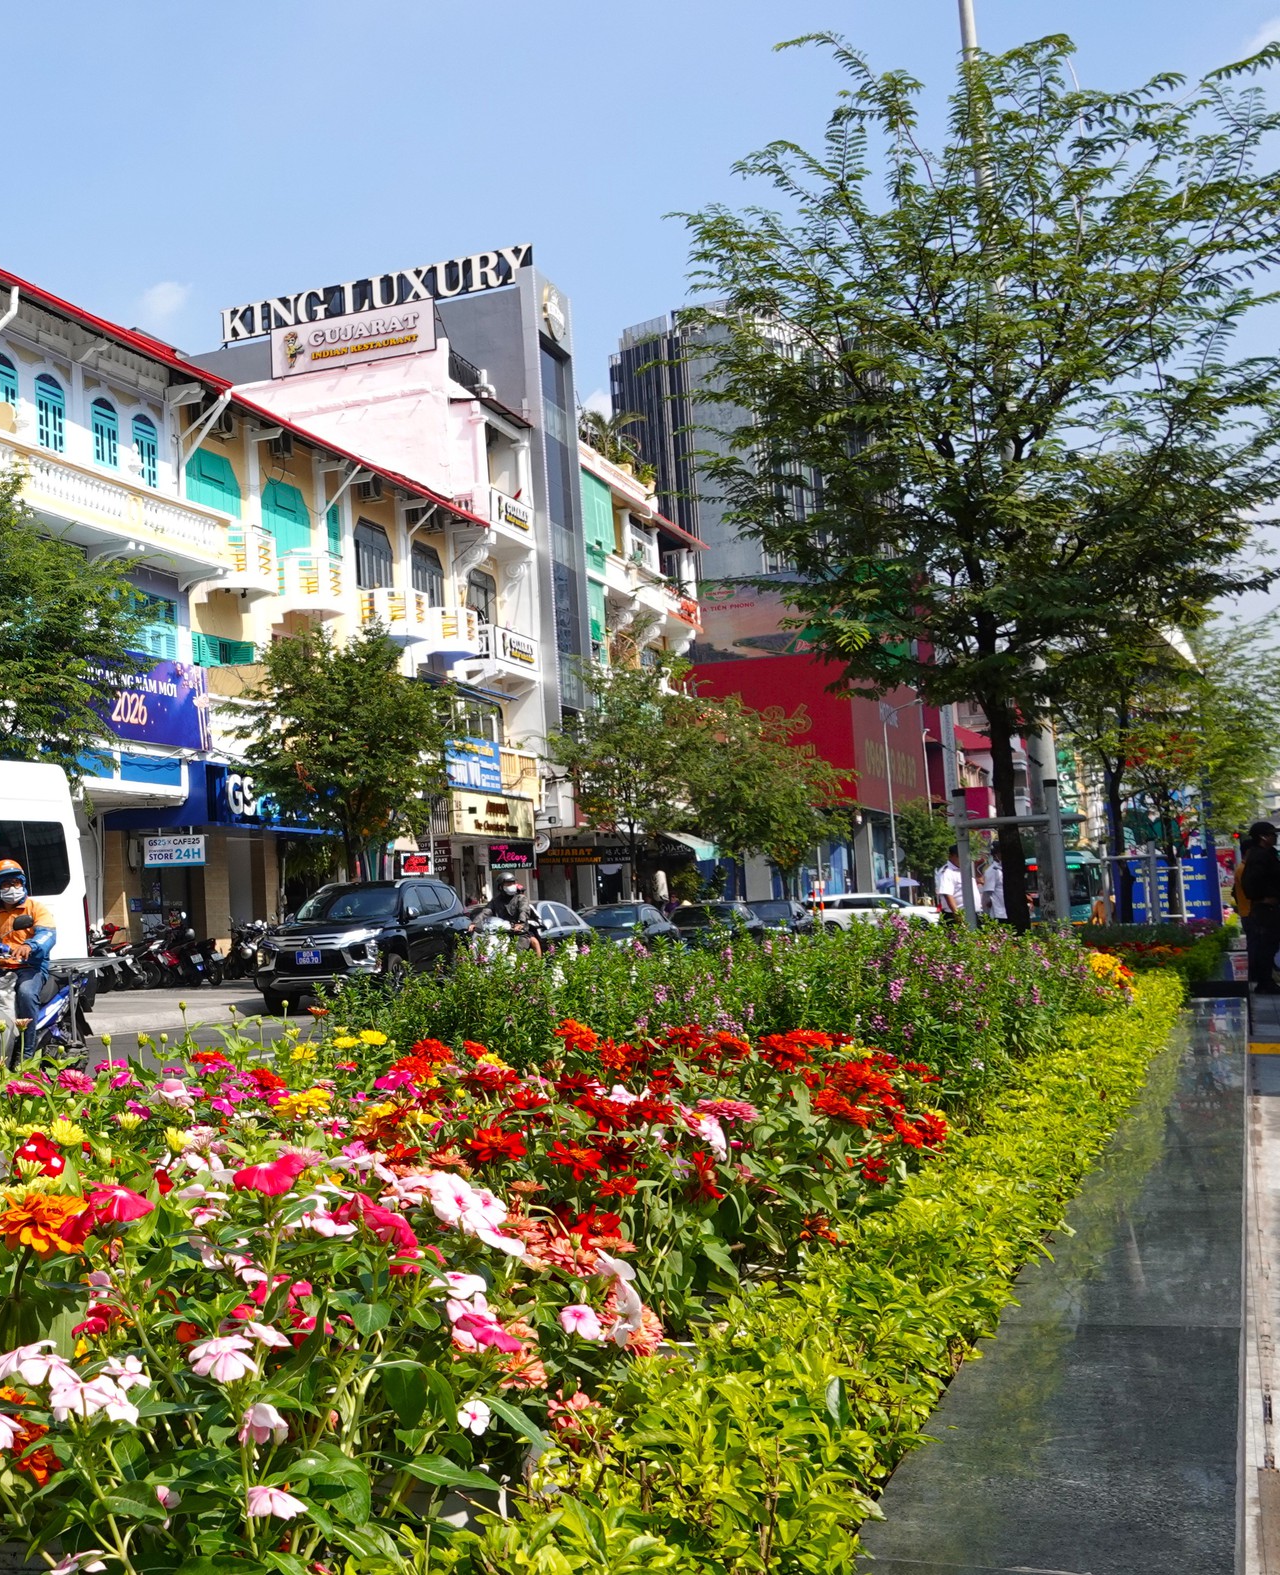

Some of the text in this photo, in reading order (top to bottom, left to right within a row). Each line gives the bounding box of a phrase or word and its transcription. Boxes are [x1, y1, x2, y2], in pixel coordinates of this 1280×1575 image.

[220, 243, 532, 343] KING LUXURY
[308, 312, 420, 347] GUJARAT
[311, 333, 419, 361] INDIAN RESTAURANT
[730, 601, 755, 609] PHONG
[134, 674, 158, 694] NĂM
[158, 678, 178, 698] MỚI
[111, 690, 148, 726] 2026
[148, 839, 166, 847] GS25
[547, 848, 593, 856] GUJARAT
[149, 852, 173, 861] STORE
[175, 847, 201, 860] 24H
